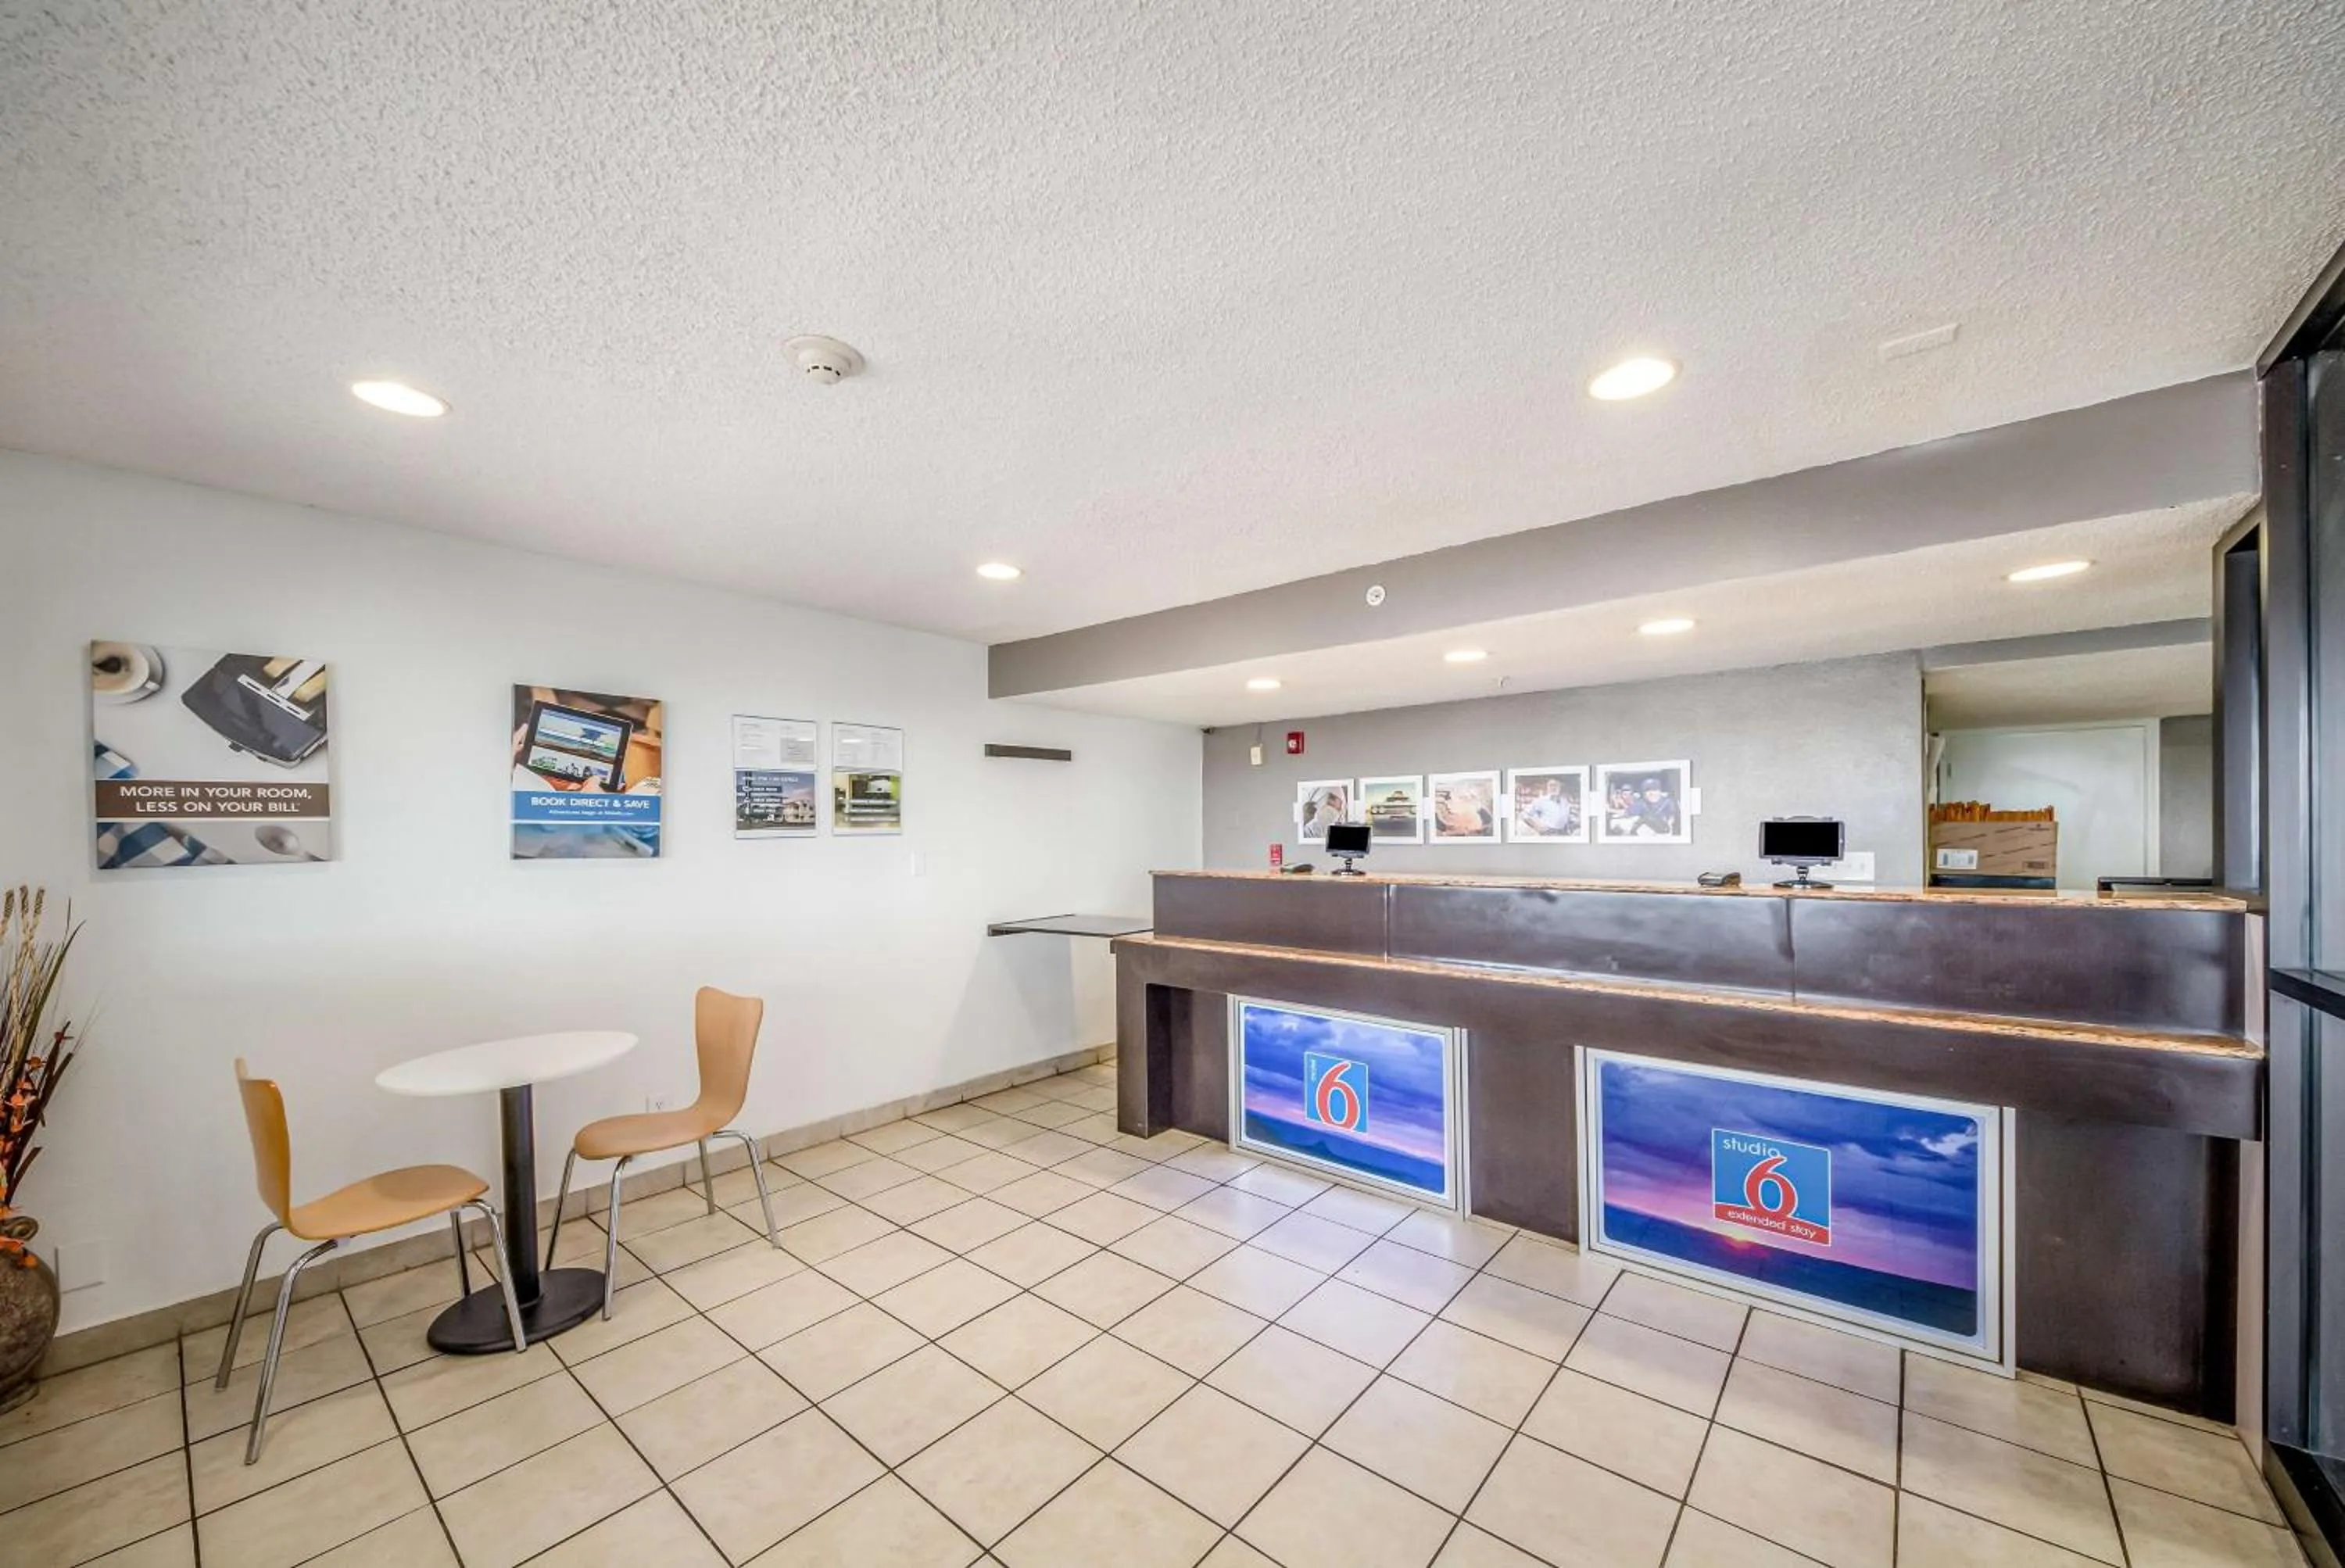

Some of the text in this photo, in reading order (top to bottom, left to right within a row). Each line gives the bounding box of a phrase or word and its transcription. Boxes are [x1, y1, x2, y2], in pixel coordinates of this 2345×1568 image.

[120, 786, 313, 800] MORE IN YOUR ROOM,
[531, 797, 650, 809] BOOK DIRECT & SAVE
[135, 801, 178, 813] LESS
[183, 801, 212, 813] ON
[217, 801, 263, 813] YOUR
[1316, 1060, 1361, 1131] 6
[1723, 1137, 1781, 1157] studio
[1744, 1155, 1798, 1218] 6
[1728, 1210, 1816, 1239] extended stay
